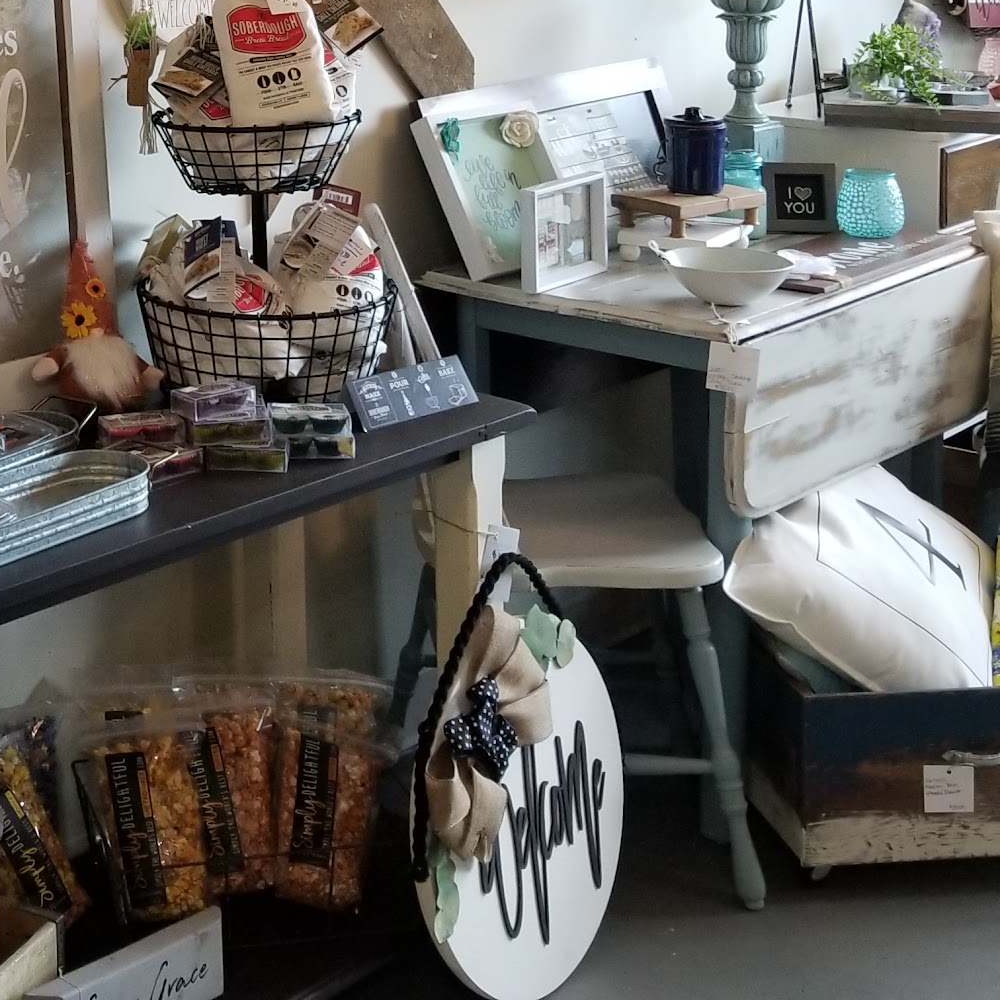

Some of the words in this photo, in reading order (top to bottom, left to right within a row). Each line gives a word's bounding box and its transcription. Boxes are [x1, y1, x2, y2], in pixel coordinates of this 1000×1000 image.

[231, 14, 299, 37] SOBERDOUGH
[503, 168, 522, 191] in
[787, 186, 792, 200] I
[783, 201, 816, 215] YOU
[389, 379, 410, 391] POUR
[300, 739, 321, 797] DELIGHTFUL
[110, 757, 136, 830] DELIGHTFUL
[201, 798, 226, 859] Simply
[292, 796, 327, 849] Simply
[19, 846, 55, 908] Simply
[149, 960, 209, 1000] Grace
